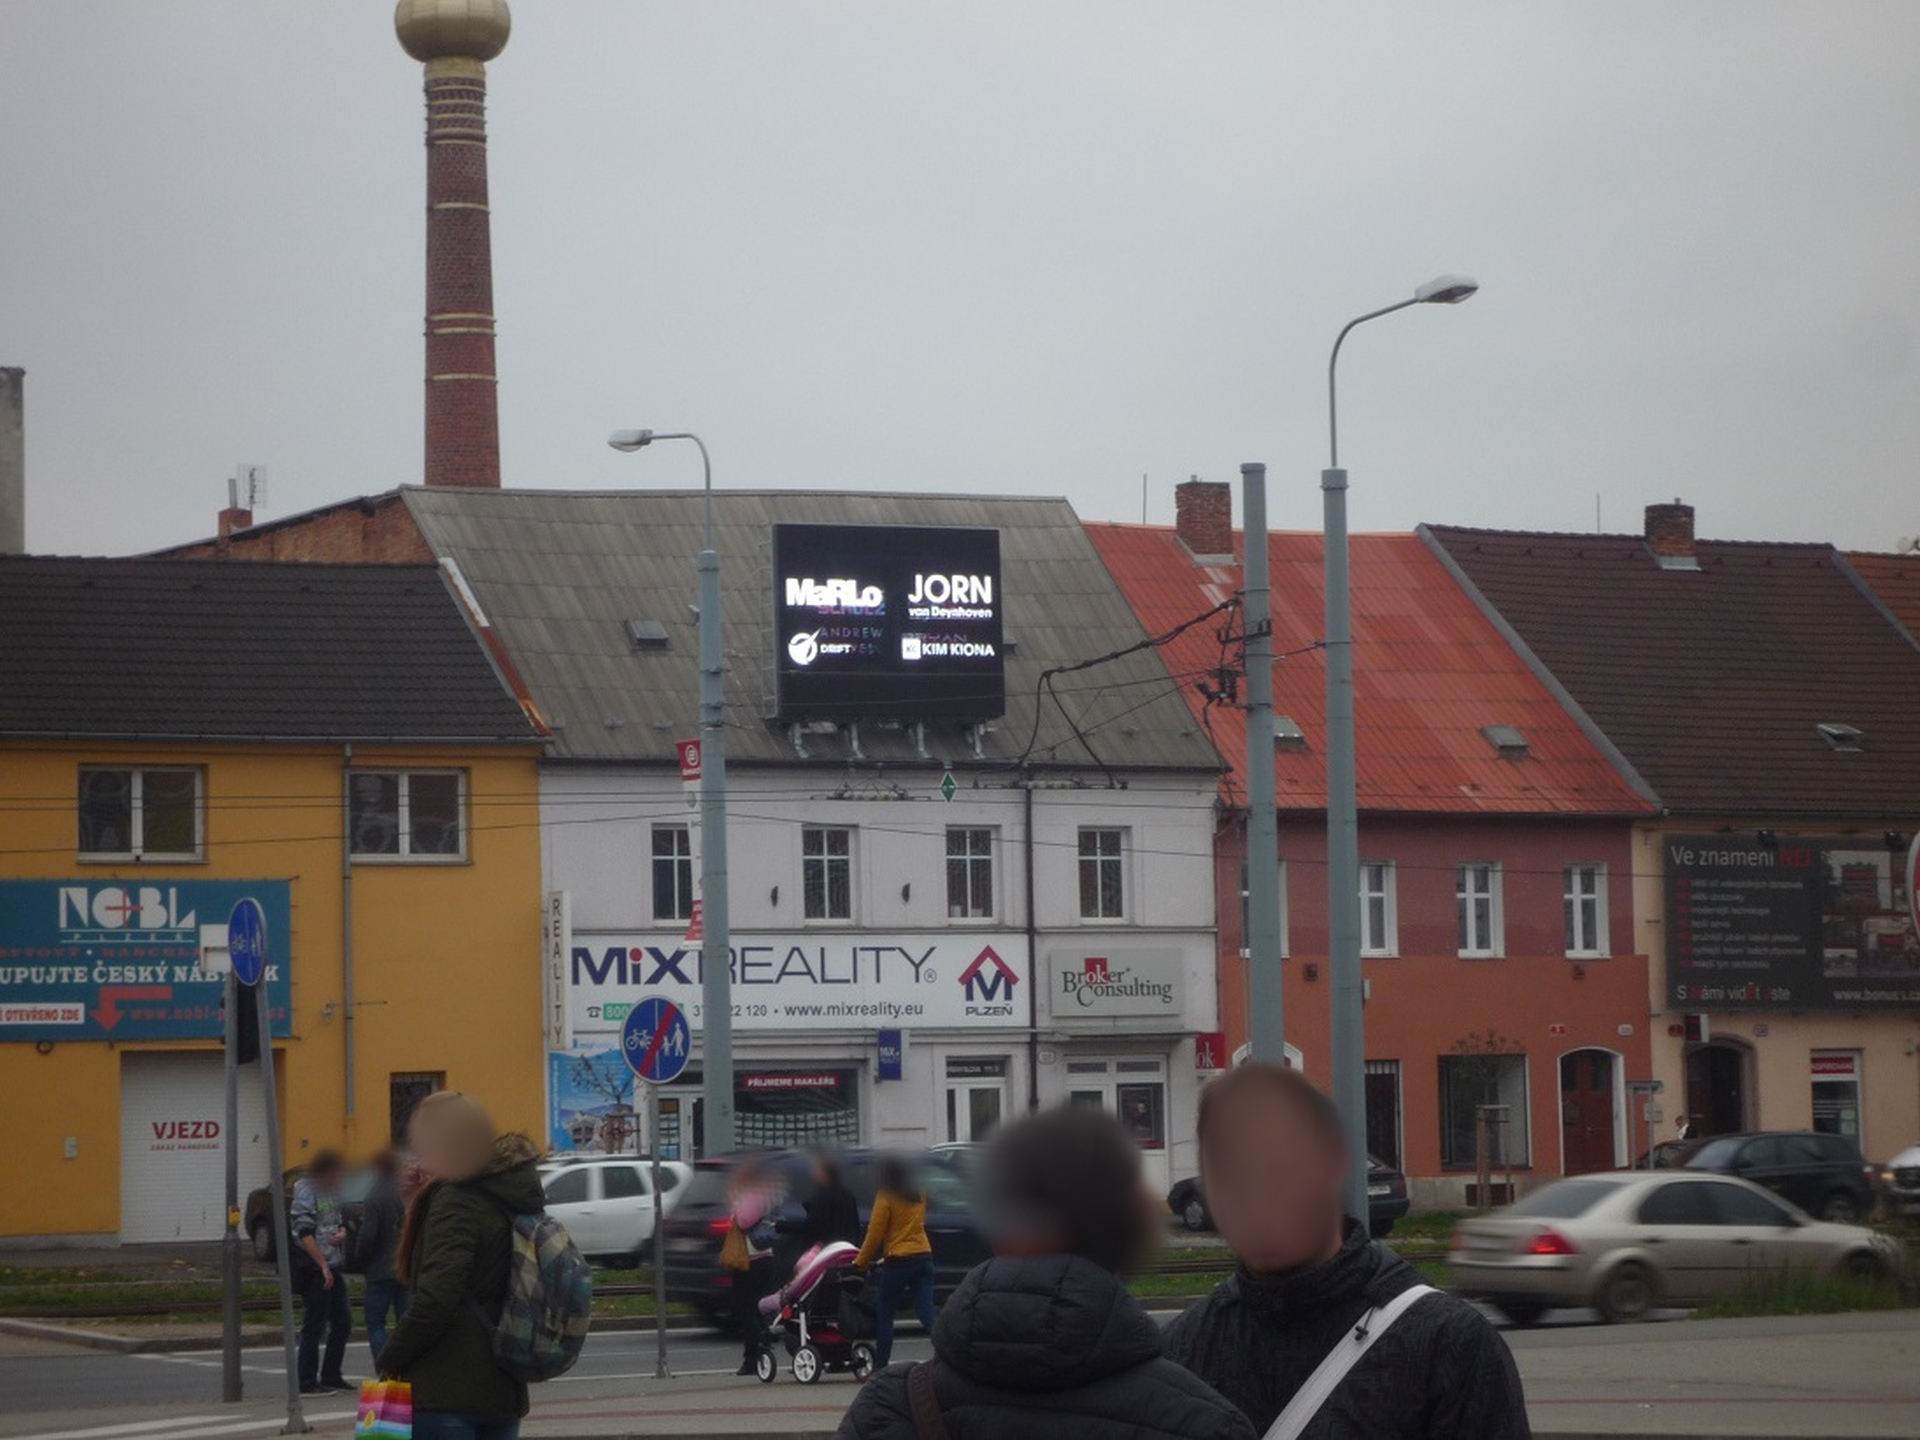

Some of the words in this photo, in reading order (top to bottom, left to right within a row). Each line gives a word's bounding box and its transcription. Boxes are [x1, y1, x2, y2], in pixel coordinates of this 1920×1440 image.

[908, 574, 993, 604] JORN
[909, 606, 930, 619] van
[820, 626, 883, 639] ANDREW
[922, 643, 948, 656] KIM
[950, 643, 995, 657] KIONA
[1671, 846, 1695, 866] Ve
[59, 887, 196, 929] NOBL
[0, 966, 89, 985] UPUJTE
[93, 960, 168, 984] ČESKÝ
[552, 898, 561, 1044] REALITY
[1061, 963, 1126, 994] Broker
[1076, 976, 1173, 1008] Consulting
[61, 1008, 80, 1021] ZDE
[746, 1005, 767, 1017] 120
[784, 1001, 924, 1019] www.mixreality.eu
[965, 1003, 1013, 1016] PLZEŇ
[152, 1121, 220, 1140] VJEZD
